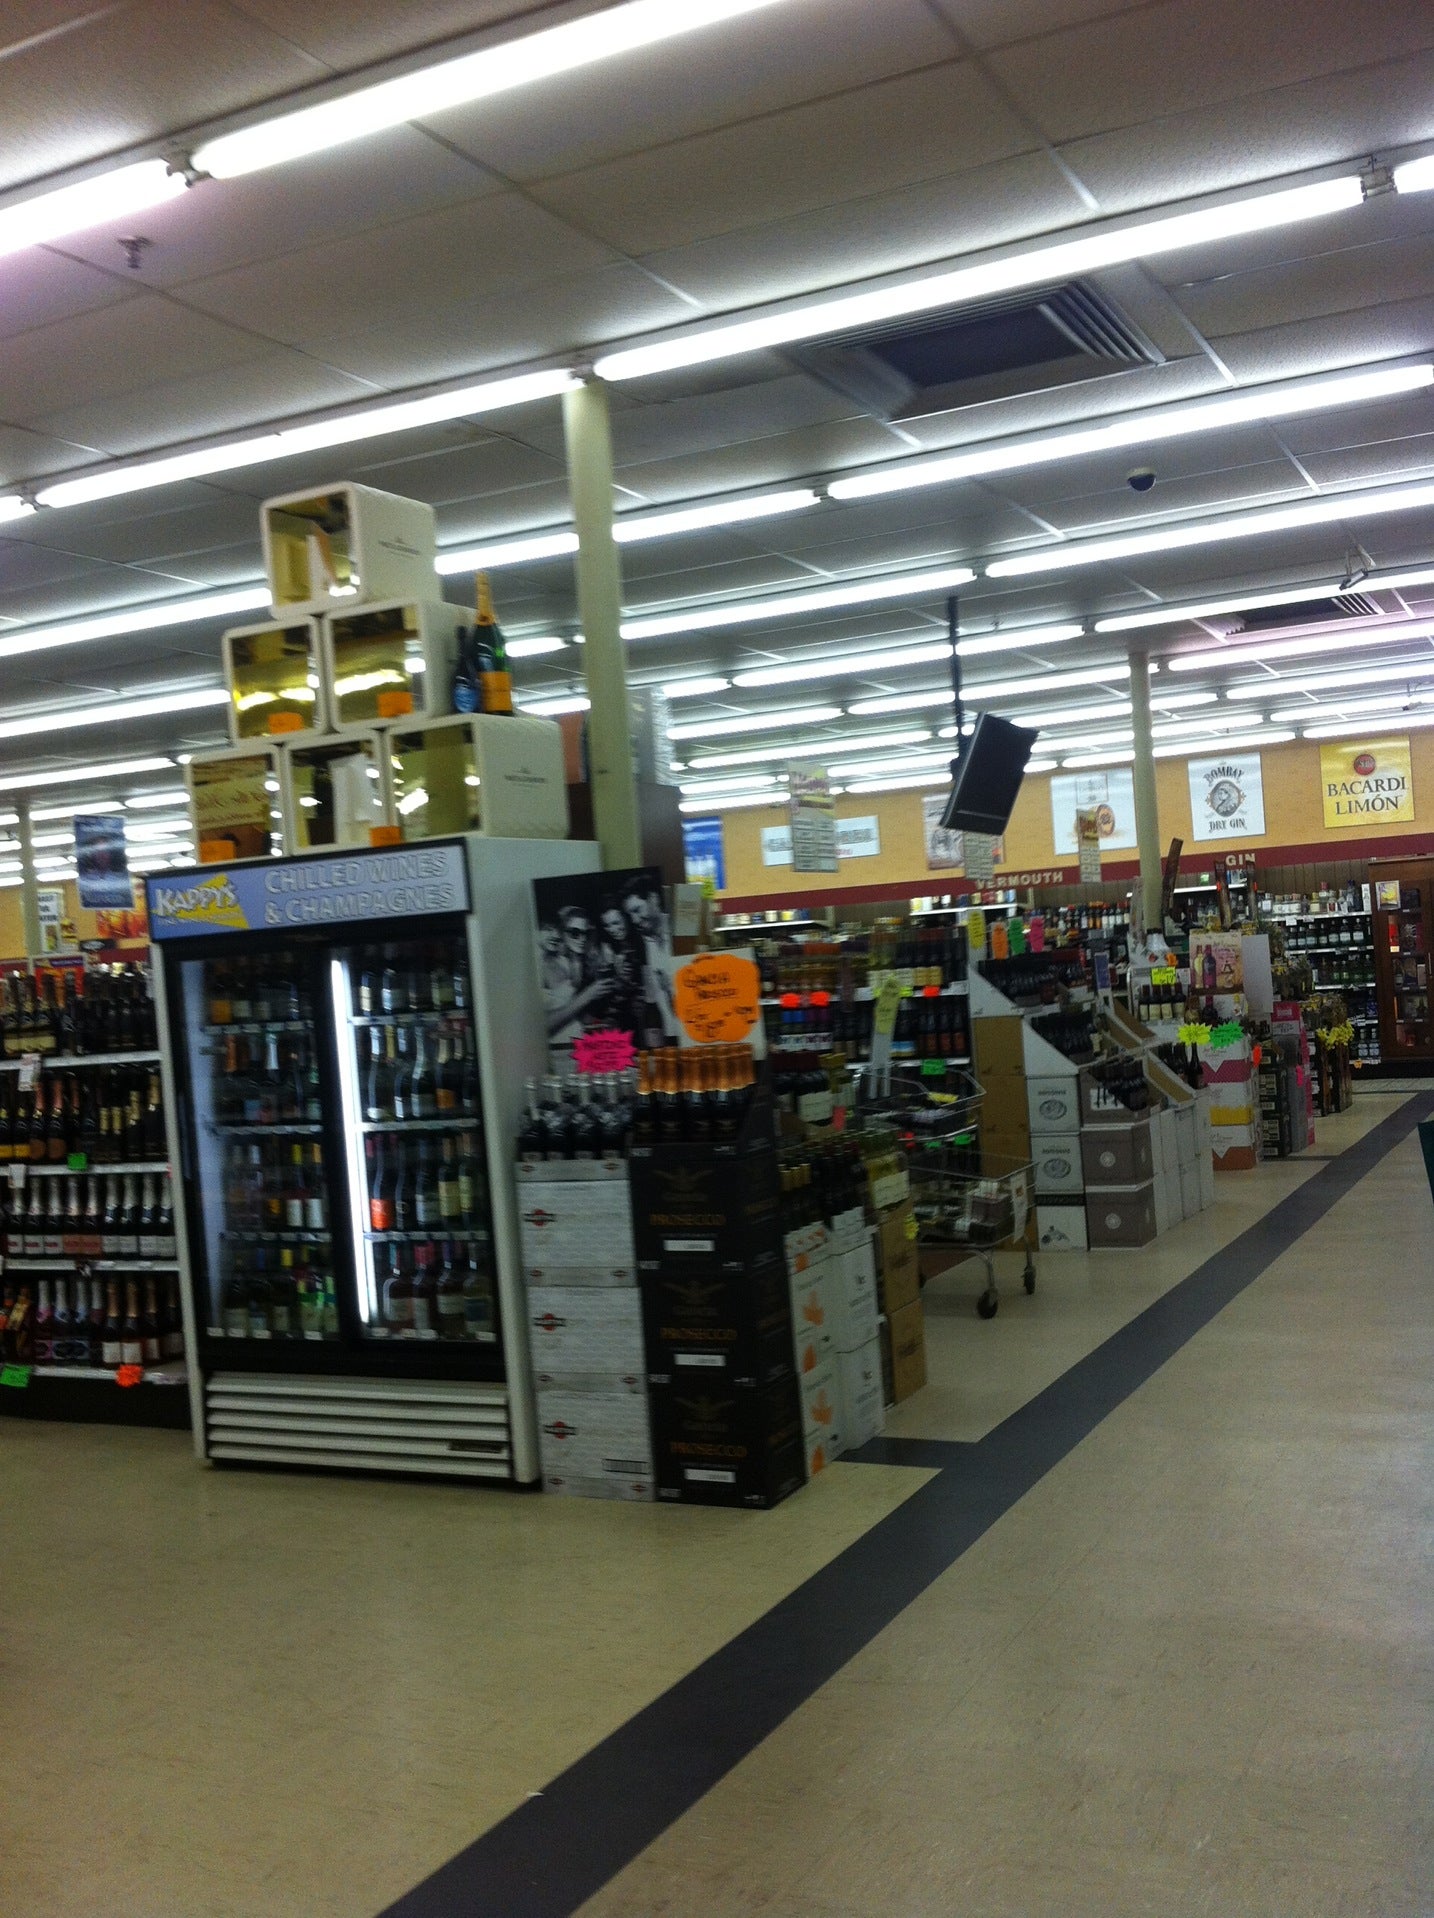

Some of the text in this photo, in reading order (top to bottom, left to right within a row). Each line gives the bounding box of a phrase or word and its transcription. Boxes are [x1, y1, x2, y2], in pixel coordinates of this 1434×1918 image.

[1203, 766, 1244, 787] BOMBAY
[1327, 776, 1406, 797] BACARDI
[1335, 793, 1399, 815] LIMÓN
[1208, 818, 1247, 833] DRY GIN
[1225, 852, 1256, 867] GIN
[264, 850, 449, 894] CHILLED WINES
[975, 871, 1063, 890] VERMOUTH
[264, 900, 284, 926] &
[285, 883, 455, 923] CHAMPAGNES
